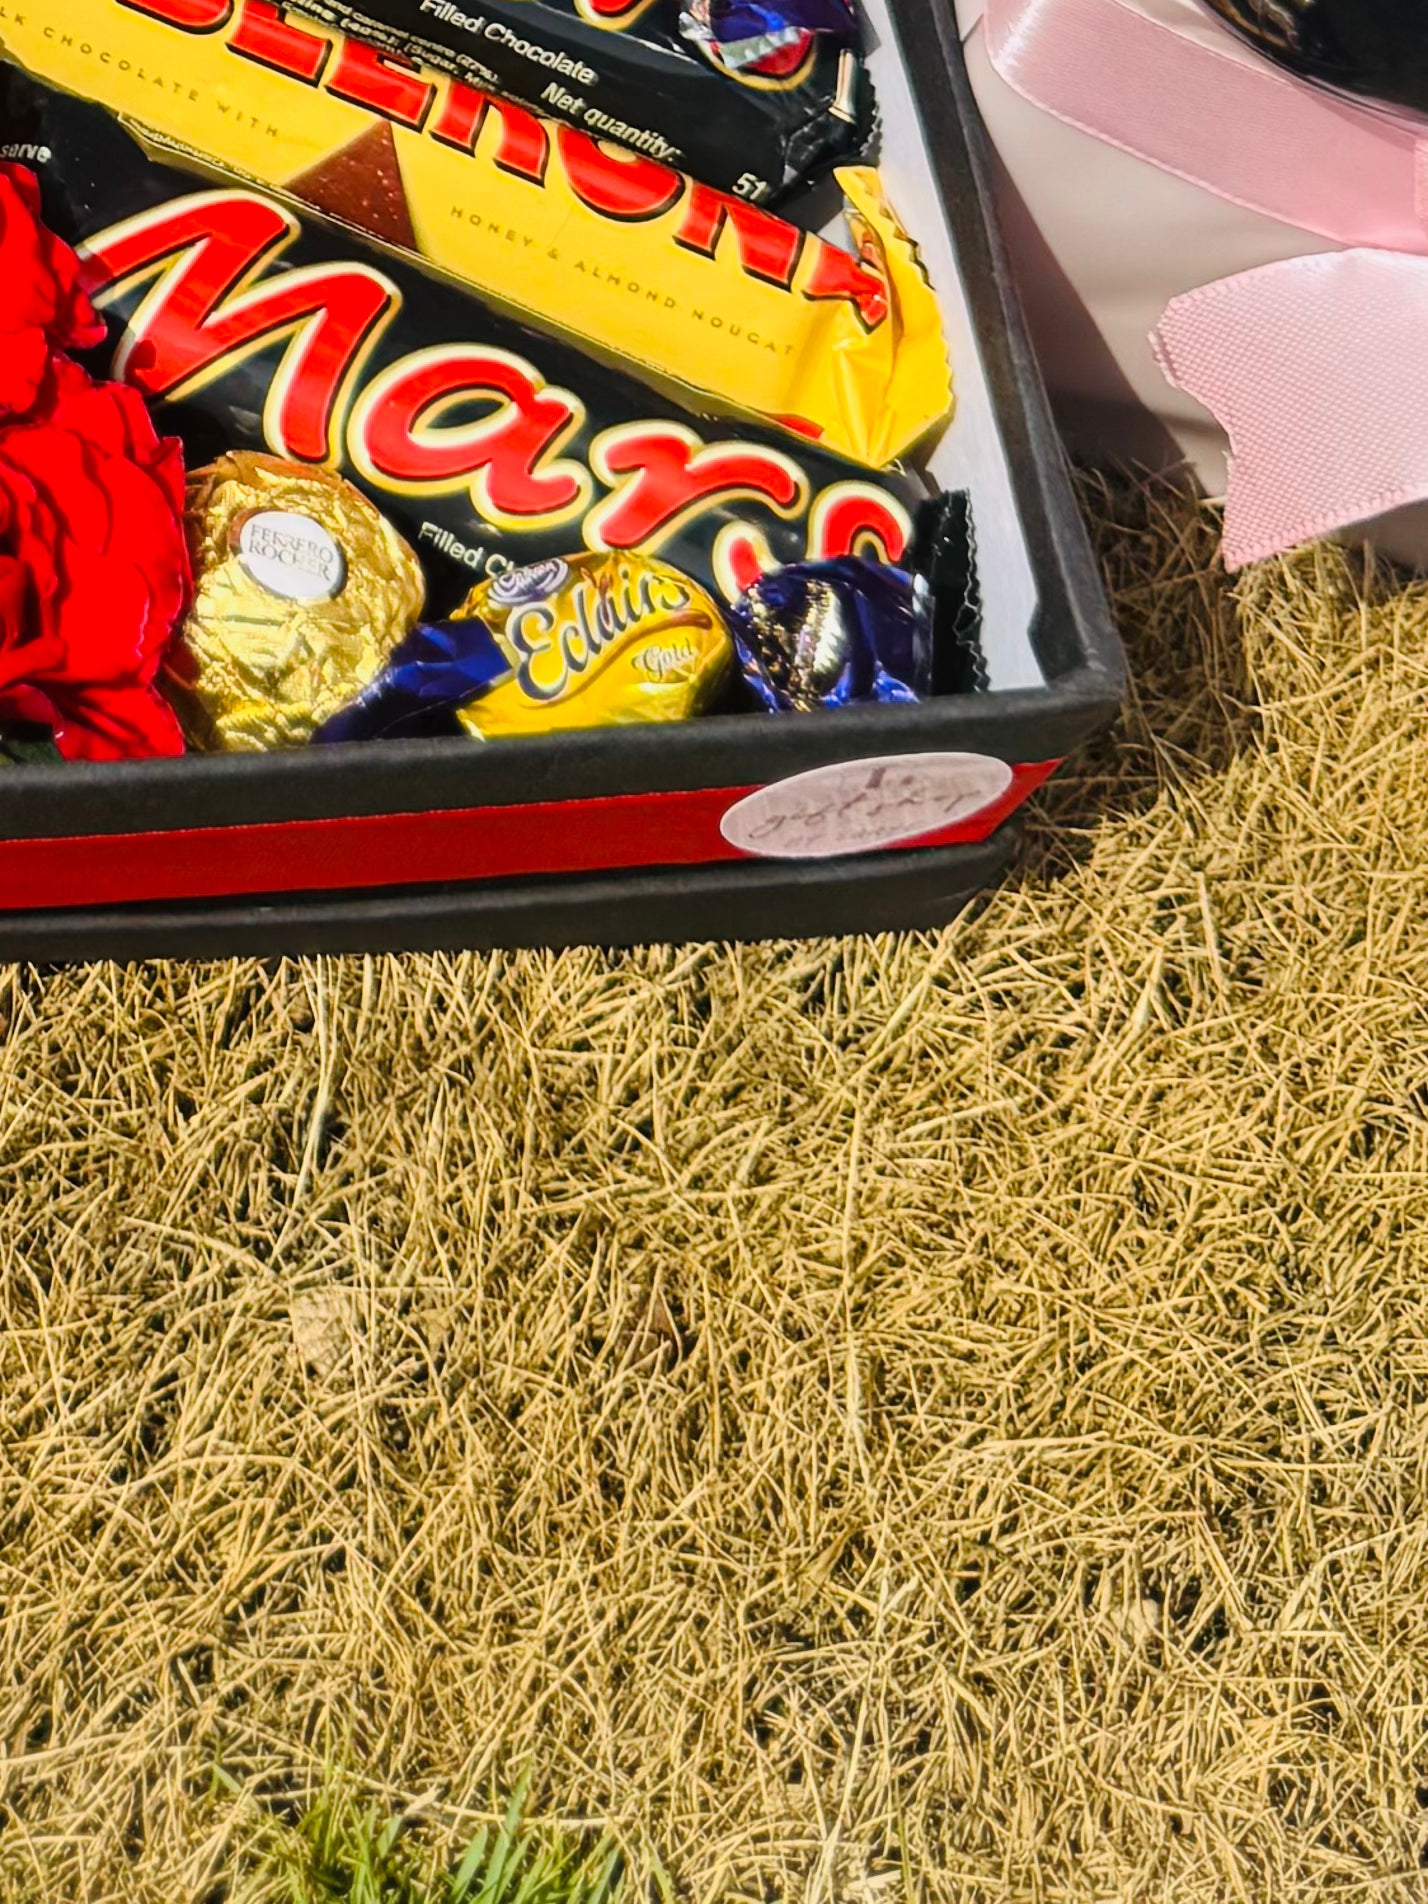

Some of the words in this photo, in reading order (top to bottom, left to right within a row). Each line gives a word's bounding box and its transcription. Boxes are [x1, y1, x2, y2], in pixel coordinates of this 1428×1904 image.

[43, 25, 199, 103] CHOCOLATE
[217, 99, 280, 138] WITH
[485, 22, 598, 85] Chocolate
[541, 81, 580, 114] Net
[583, 102, 686, 162] quantity:
[450, 204, 534, 250] HONEY
[547, 243, 560, 260] &
[574, 258, 677, 310] ALMOND
[692, 307, 795, 357] NOUGAT
[248, 540, 332, 581] ROCHER
[250, 522, 335, 564] FERRERO
[417, 520, 484, 572] Filled
[505, 565, 691, 702] Eclairs
[631, 639, 697, 683] Gold
